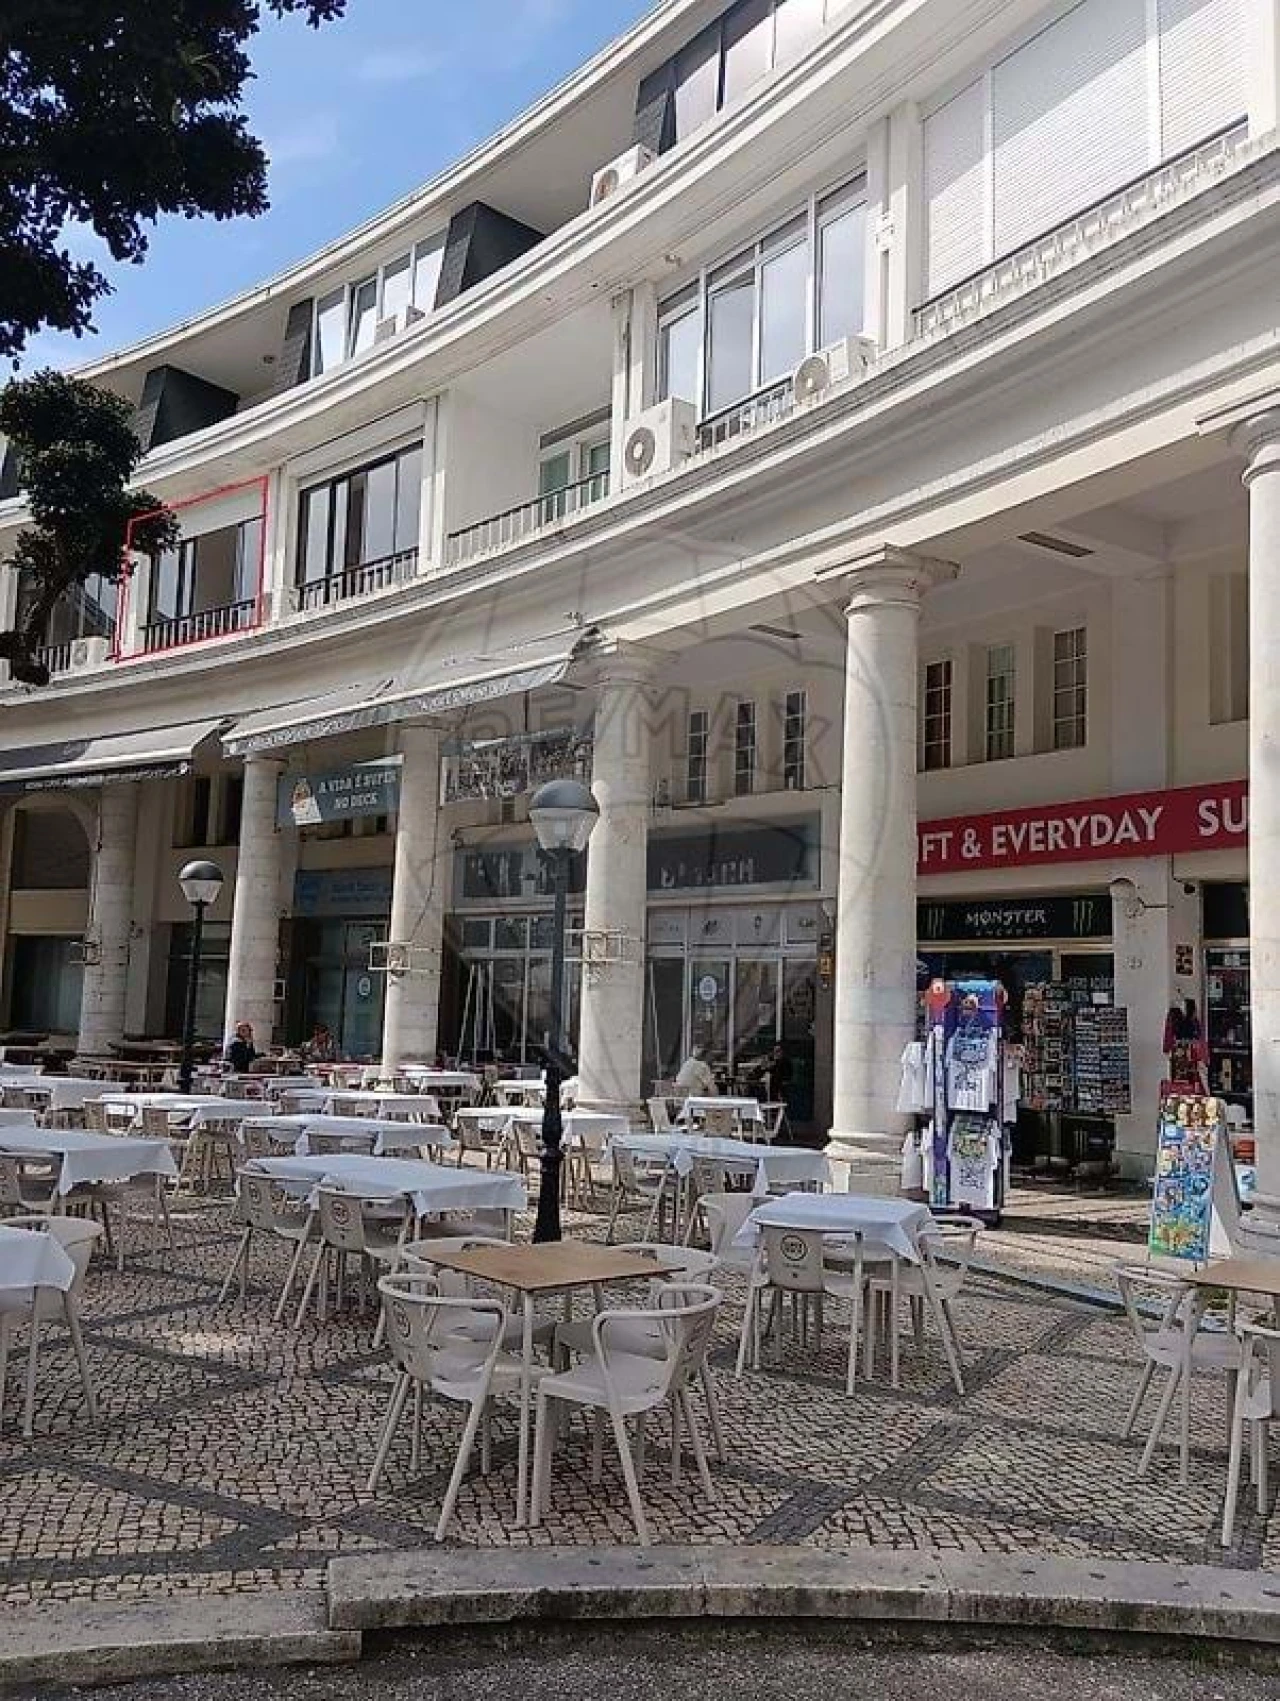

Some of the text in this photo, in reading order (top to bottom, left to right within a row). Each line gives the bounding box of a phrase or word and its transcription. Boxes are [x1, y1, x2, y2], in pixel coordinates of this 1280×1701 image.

[961, 828, 981, 859] &
[992, 806, 1162, 855] EVERYDAY
[965, 909, 1046, 927] MONSTER
